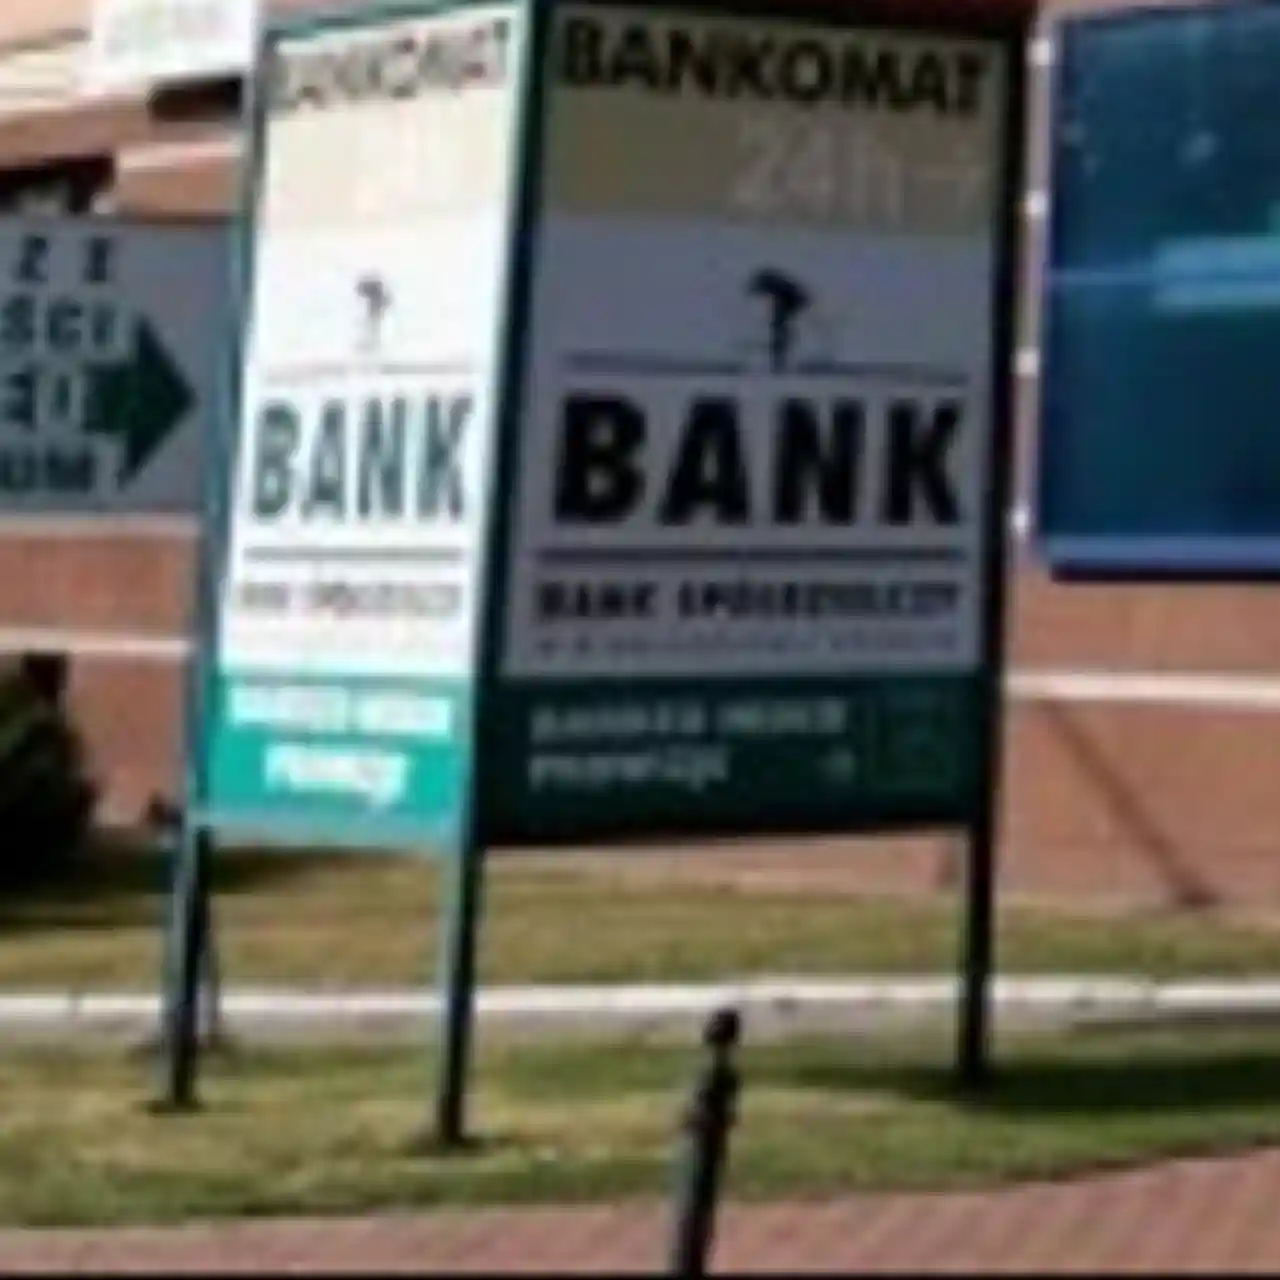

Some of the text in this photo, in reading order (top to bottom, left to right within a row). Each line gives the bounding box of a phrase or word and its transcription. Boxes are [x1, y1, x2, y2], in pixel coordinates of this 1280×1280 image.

[560, 14, 992, 118] BANKOMAT
[249, 394, 472, 526] BANK
[553, 392, 966, 530] BANK
